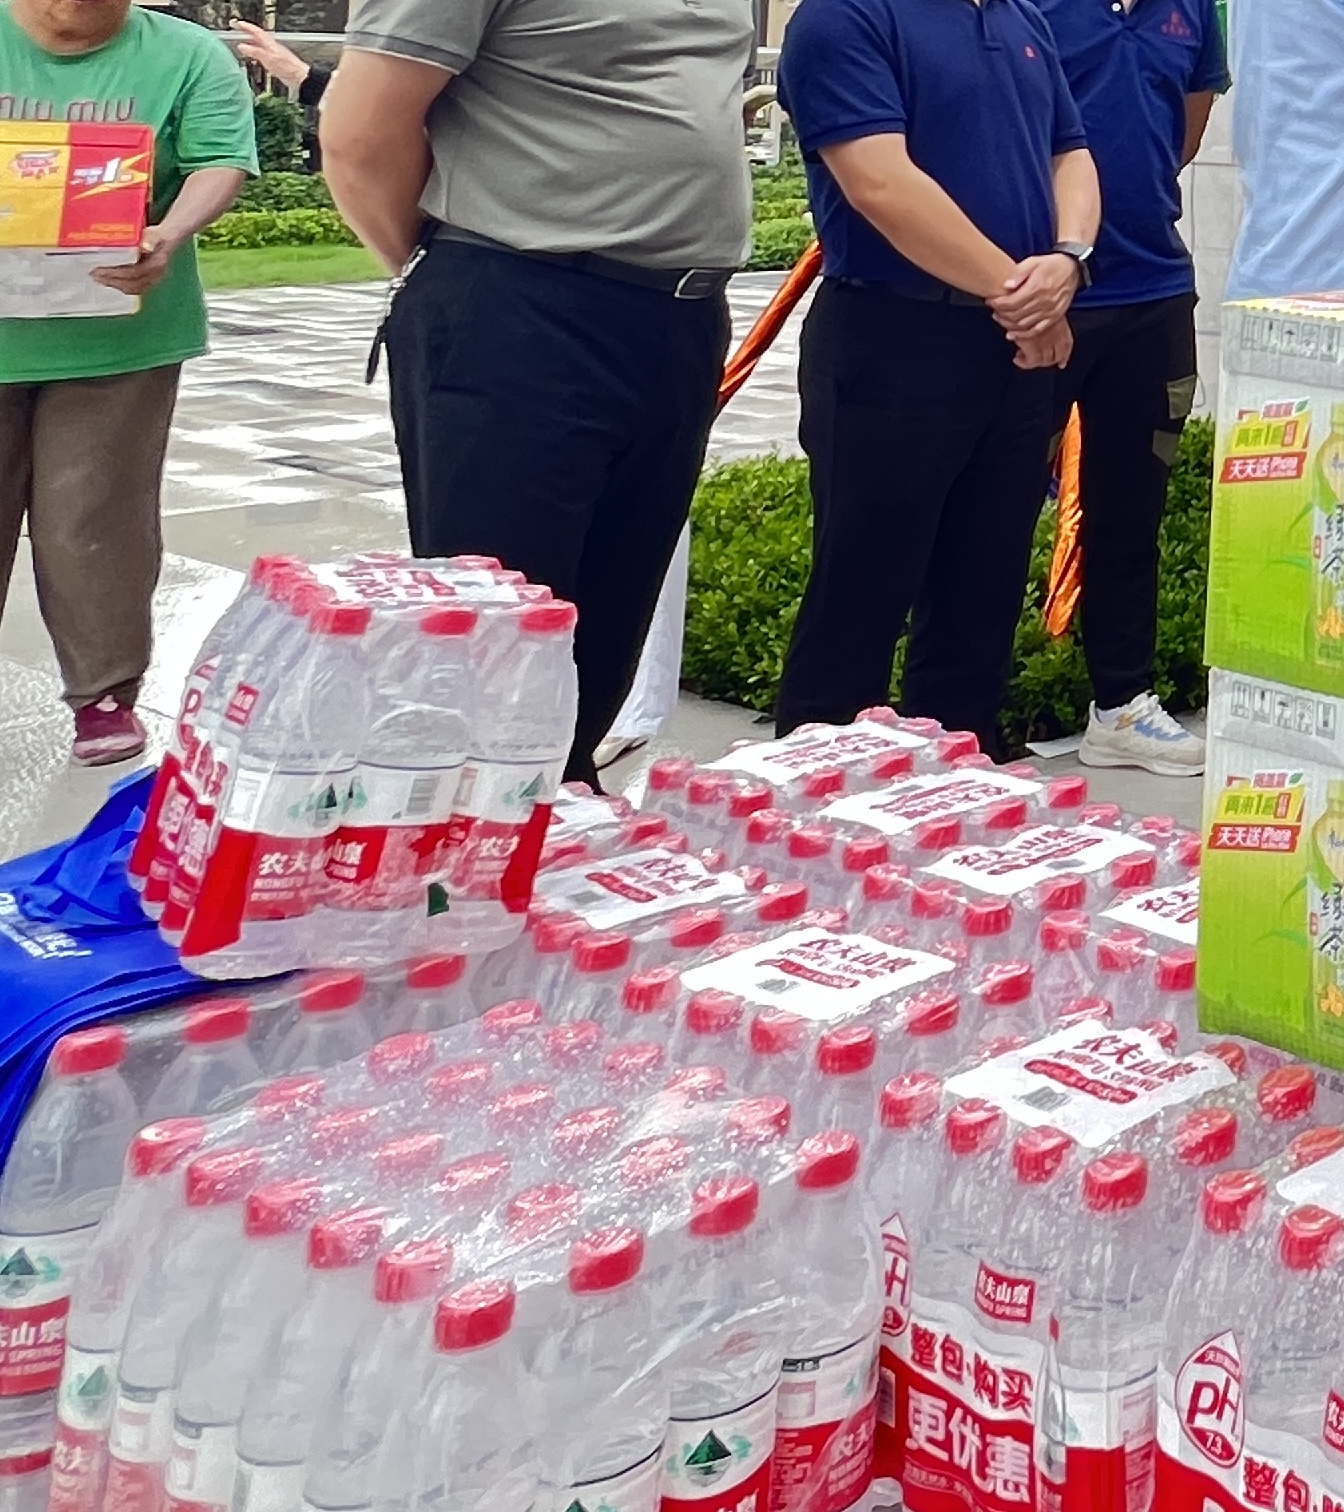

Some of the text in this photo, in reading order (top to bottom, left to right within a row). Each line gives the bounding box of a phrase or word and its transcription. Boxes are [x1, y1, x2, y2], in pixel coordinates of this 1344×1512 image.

[1072, 1034, 1199, 1082] 农夫山泉
[1185, 1376, 1239, 1436] pH
[905, 1384, 1031, 1505] 更优惠
